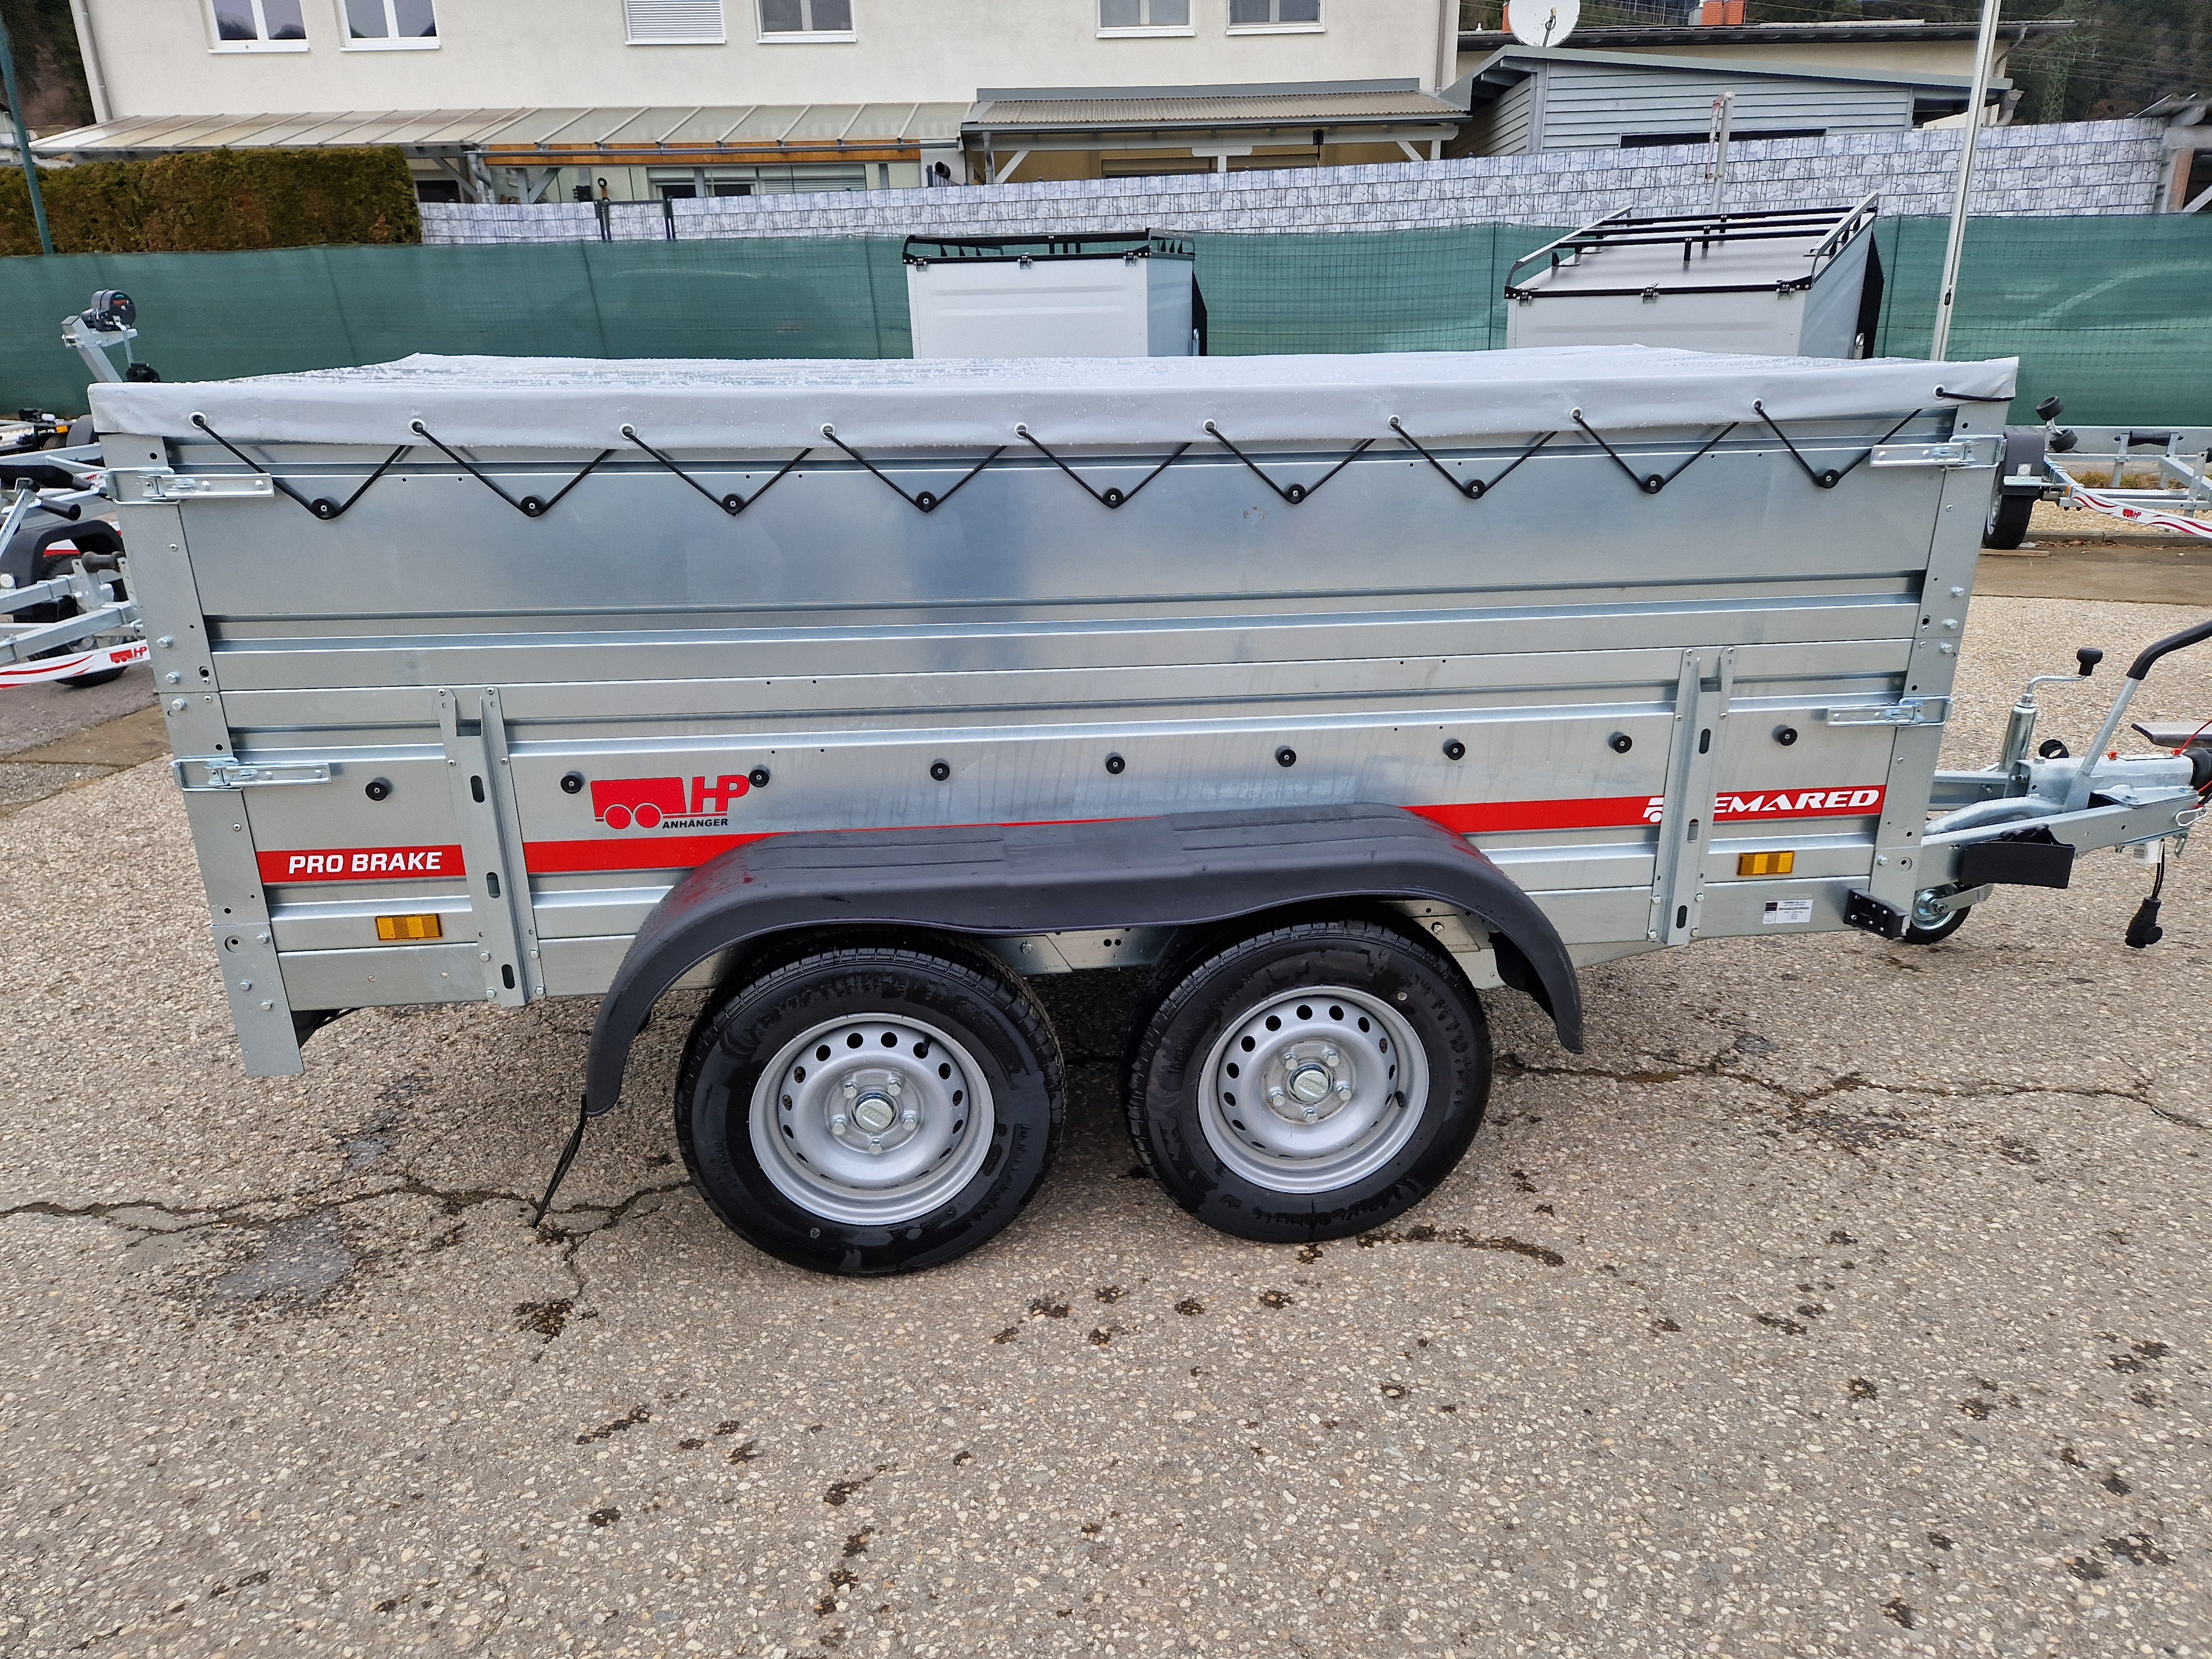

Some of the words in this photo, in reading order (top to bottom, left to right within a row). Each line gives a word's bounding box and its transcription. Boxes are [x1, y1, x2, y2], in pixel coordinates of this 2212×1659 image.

[133, 646, 148, 657] HP
[690, 775, 749, 812] HP
[1714, 790, 1879, 813] EMARED
[662, 818, 728, 828] ANHÄNGER
[289, 854, 343, 874] PRO
[351, 852, 442, 872] BRAKE
